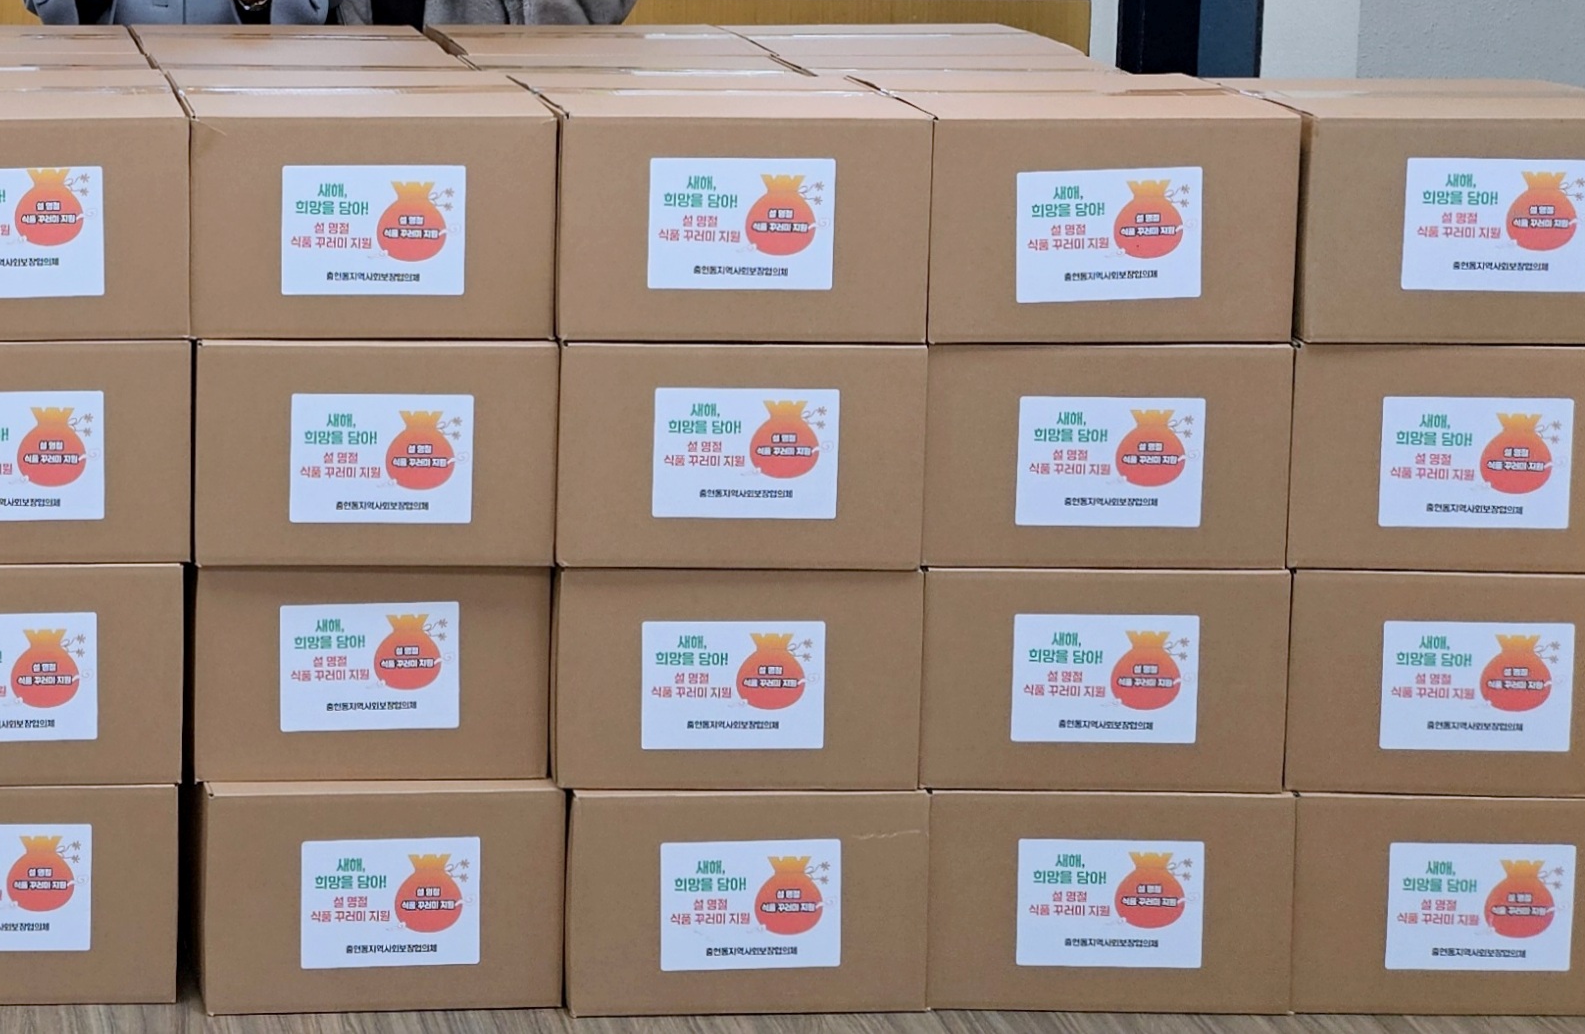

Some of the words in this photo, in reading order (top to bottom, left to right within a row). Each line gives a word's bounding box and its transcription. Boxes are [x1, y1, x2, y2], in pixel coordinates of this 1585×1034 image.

[663, 192, 703, 208] 희망을
[707, 193, 738, 209] 담아!
[682, 215, 693, 227] 설
[696, 215, 717, 228] 명절
[658, 229, 680, 241] 식품
[683, 230, 715, 242] 꾸러미
[718, 230, 740, 243] 지원
[1034, 428, 1074, 442] 희망을
[1078, 428, 1108, 443] 담아!
[1052, 449, 1063, 461] 설
[1067, 449, 1088, 461] 명절
[1029, 463, 1050, 474] 식품
[1054, 463, 1086, 475] 꾸러미
[1088, 463, 1111, 475] 지원
[1028, 649, 1069, 664] 희망을
[1073, 649, 1103, 664] 담아!
[1047, 670, 1058, 682] 설
[1061, 671, 1083, 683] 명절
[1023, 684, 1045, 696] 식품
[1048, 685, 1081, 697] 꾸러미
[1083, 685, 1106, 698] 지원
